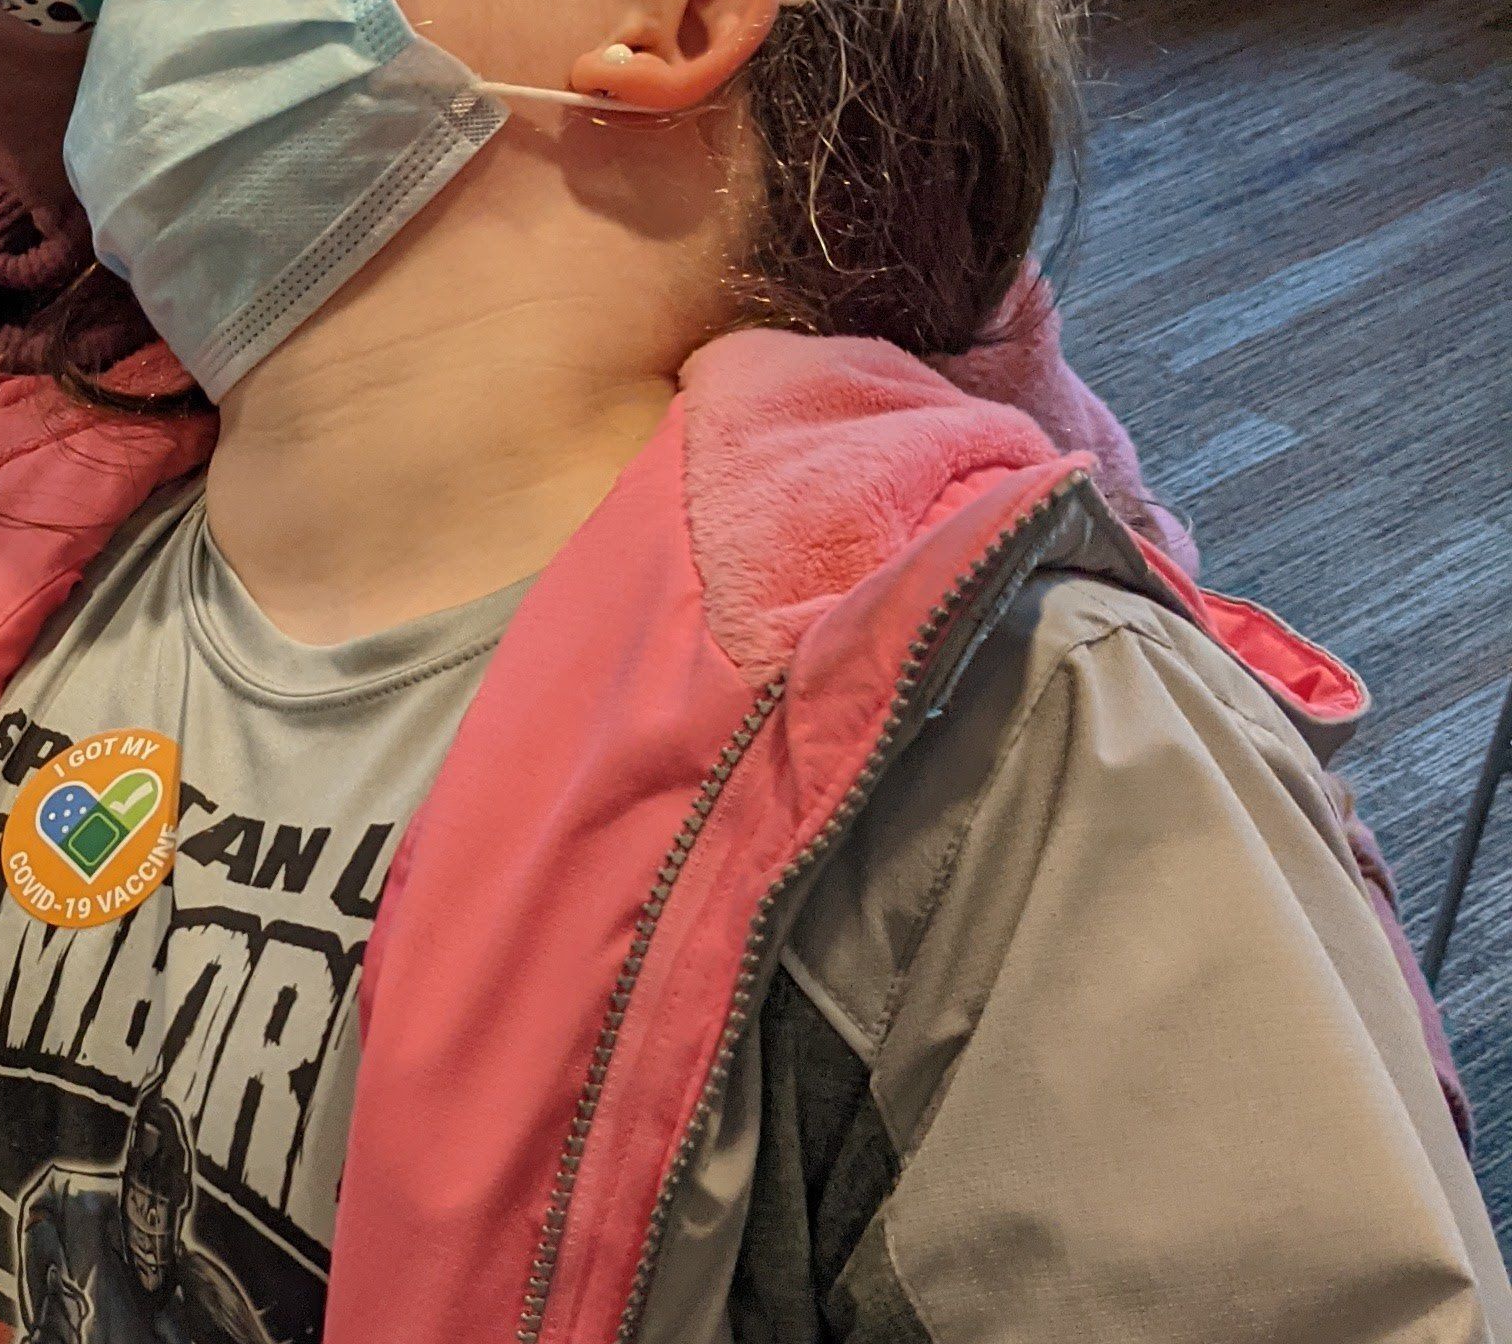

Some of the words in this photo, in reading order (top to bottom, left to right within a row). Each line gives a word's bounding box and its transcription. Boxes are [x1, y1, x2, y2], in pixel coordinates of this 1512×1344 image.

[53, 762, 65, 778] I
[68, 738, 119, 768] GOT
[120, 736, 160, 760] MY
[9, 851, 91, 919] COVID-19
